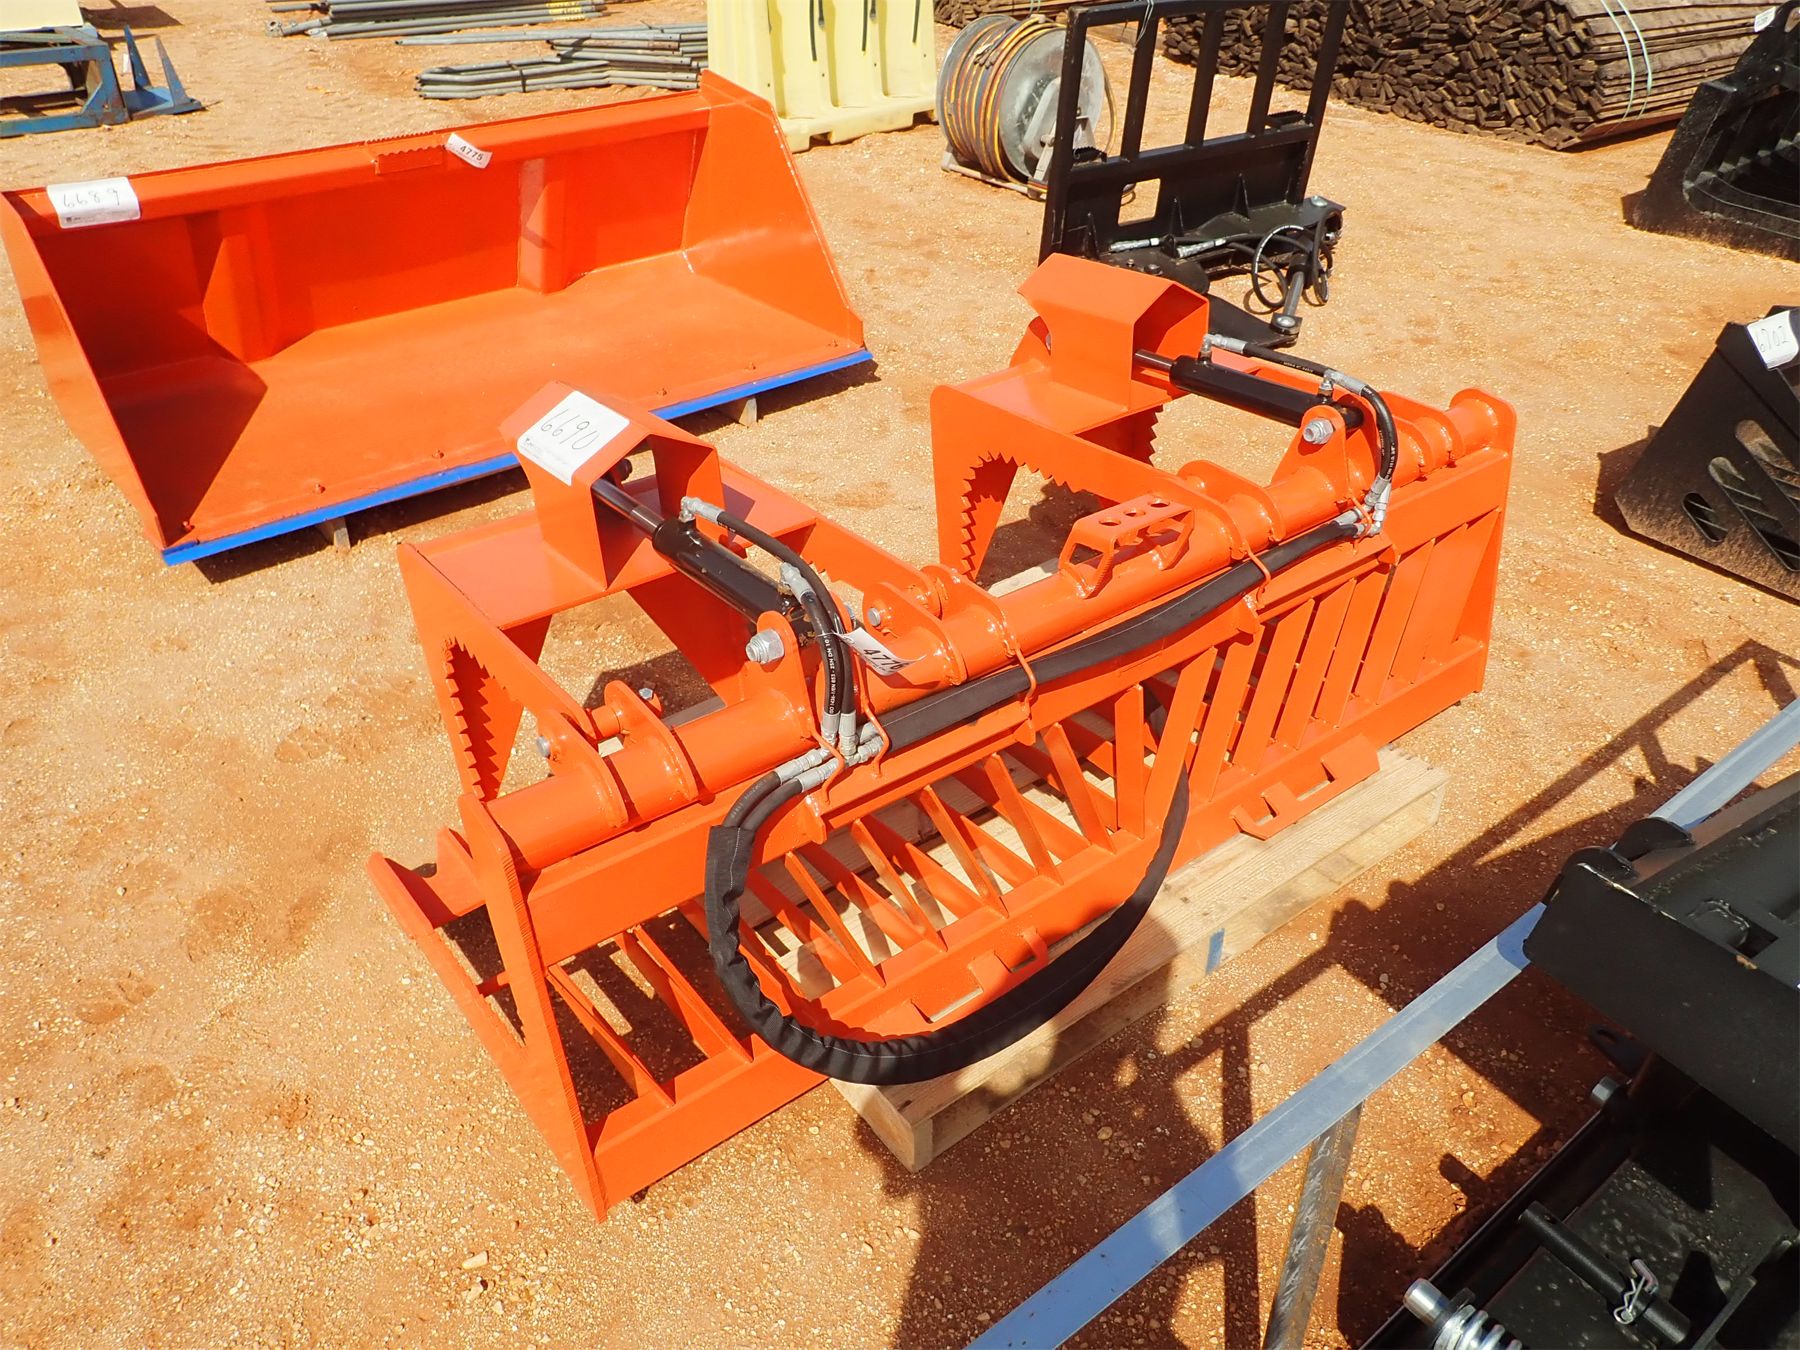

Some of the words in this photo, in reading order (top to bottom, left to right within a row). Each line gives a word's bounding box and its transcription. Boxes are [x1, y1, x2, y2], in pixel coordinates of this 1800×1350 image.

[460, 145, 484, 161] 4775
[63, 188, 120, 208] 6689
[540, 408, 601, 450] 6690
